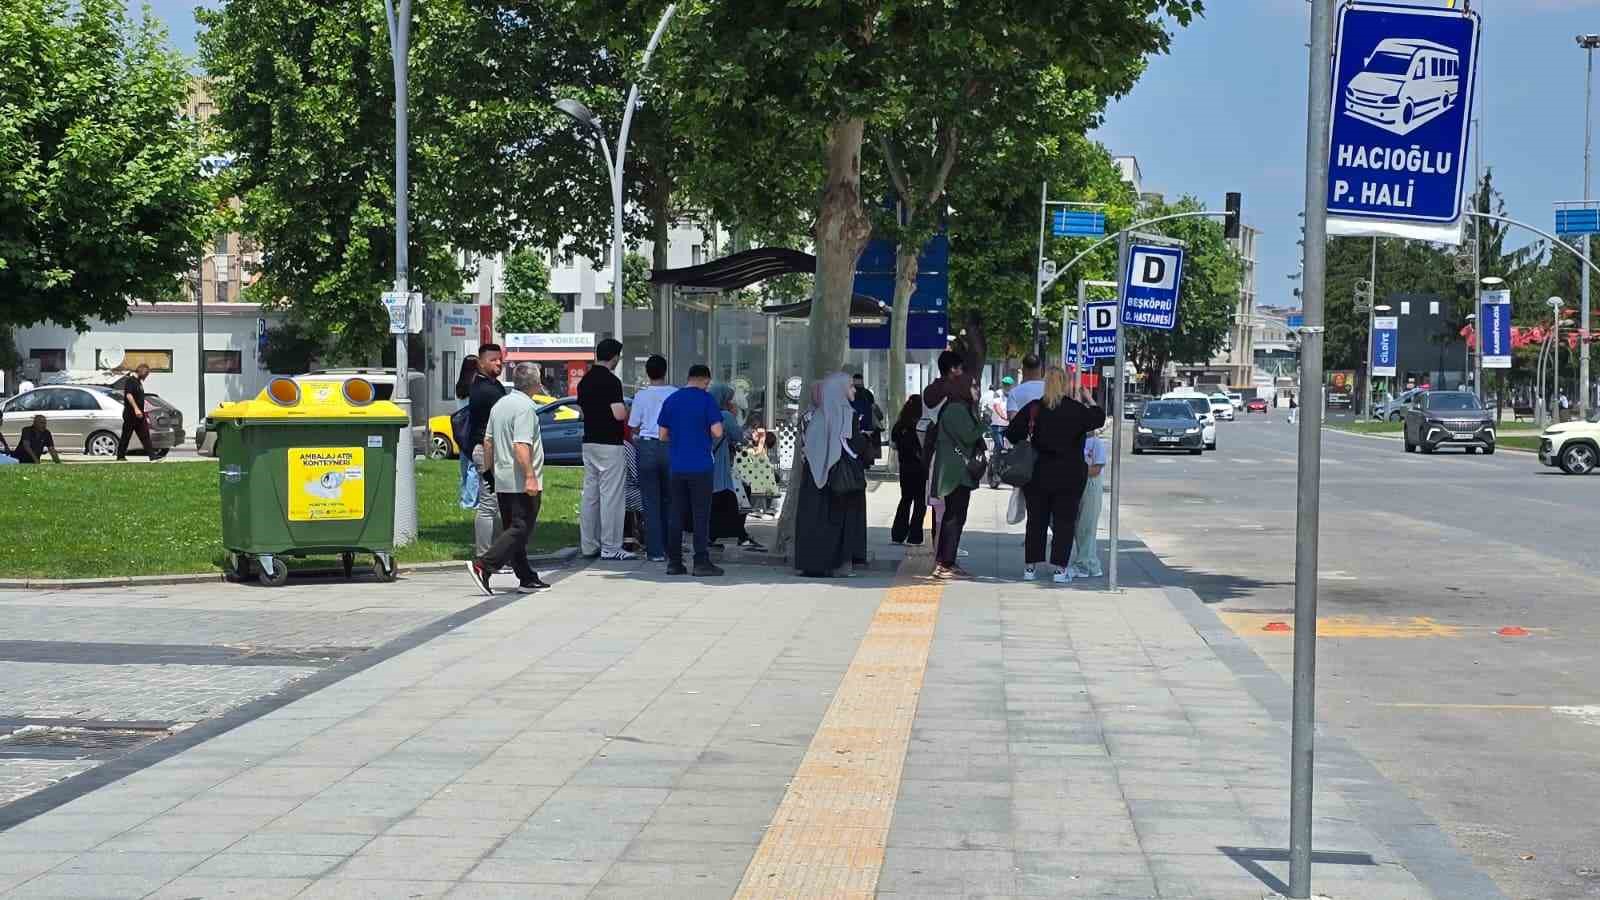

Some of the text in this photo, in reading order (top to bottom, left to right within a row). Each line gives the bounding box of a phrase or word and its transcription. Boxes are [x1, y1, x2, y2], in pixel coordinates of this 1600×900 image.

[1337, 144, 1452, 175] HACIOĞLU
[1333, 179, 1415, 208] P. HALİ
[1142, 256, 1166, 284] D
[1127, 296, 1172, 311] BEŞKÖPRÜ
[1096, 308, 1112, 329] D
[1133, 311, 1172, 325] HASTANESİ
